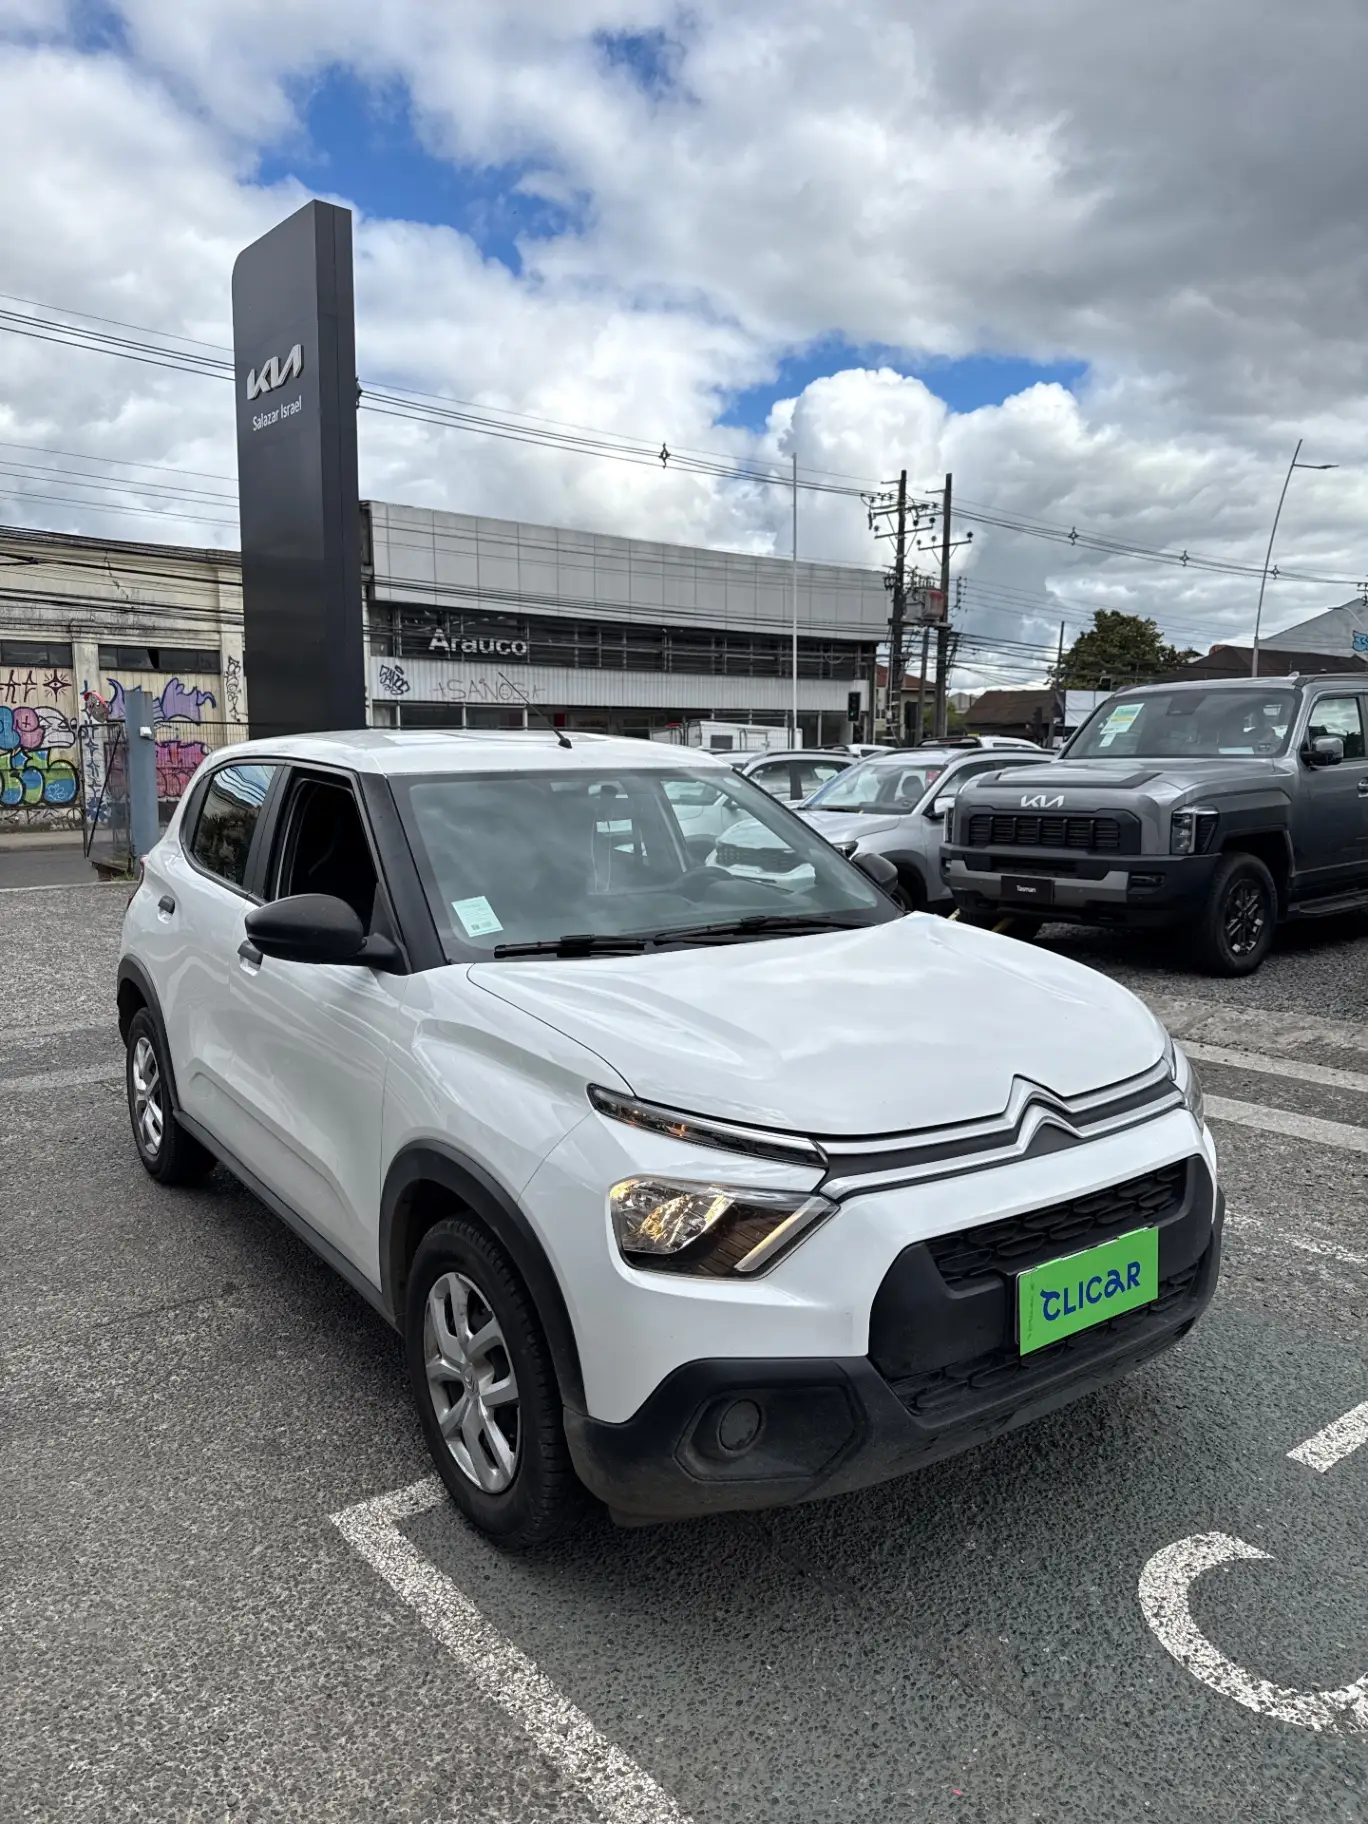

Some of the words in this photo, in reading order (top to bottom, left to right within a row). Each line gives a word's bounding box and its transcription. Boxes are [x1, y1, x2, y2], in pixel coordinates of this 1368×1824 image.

[246, 343, 303, 400] KIA
[252, 408, 279, 432] Salazar
[280, 395, 302, 420] Israel
[428, 628, 529, 656] Arauco
[1020, 794, 1065, 808] KIA
[1016, 884, 1037, 893] Tasman
